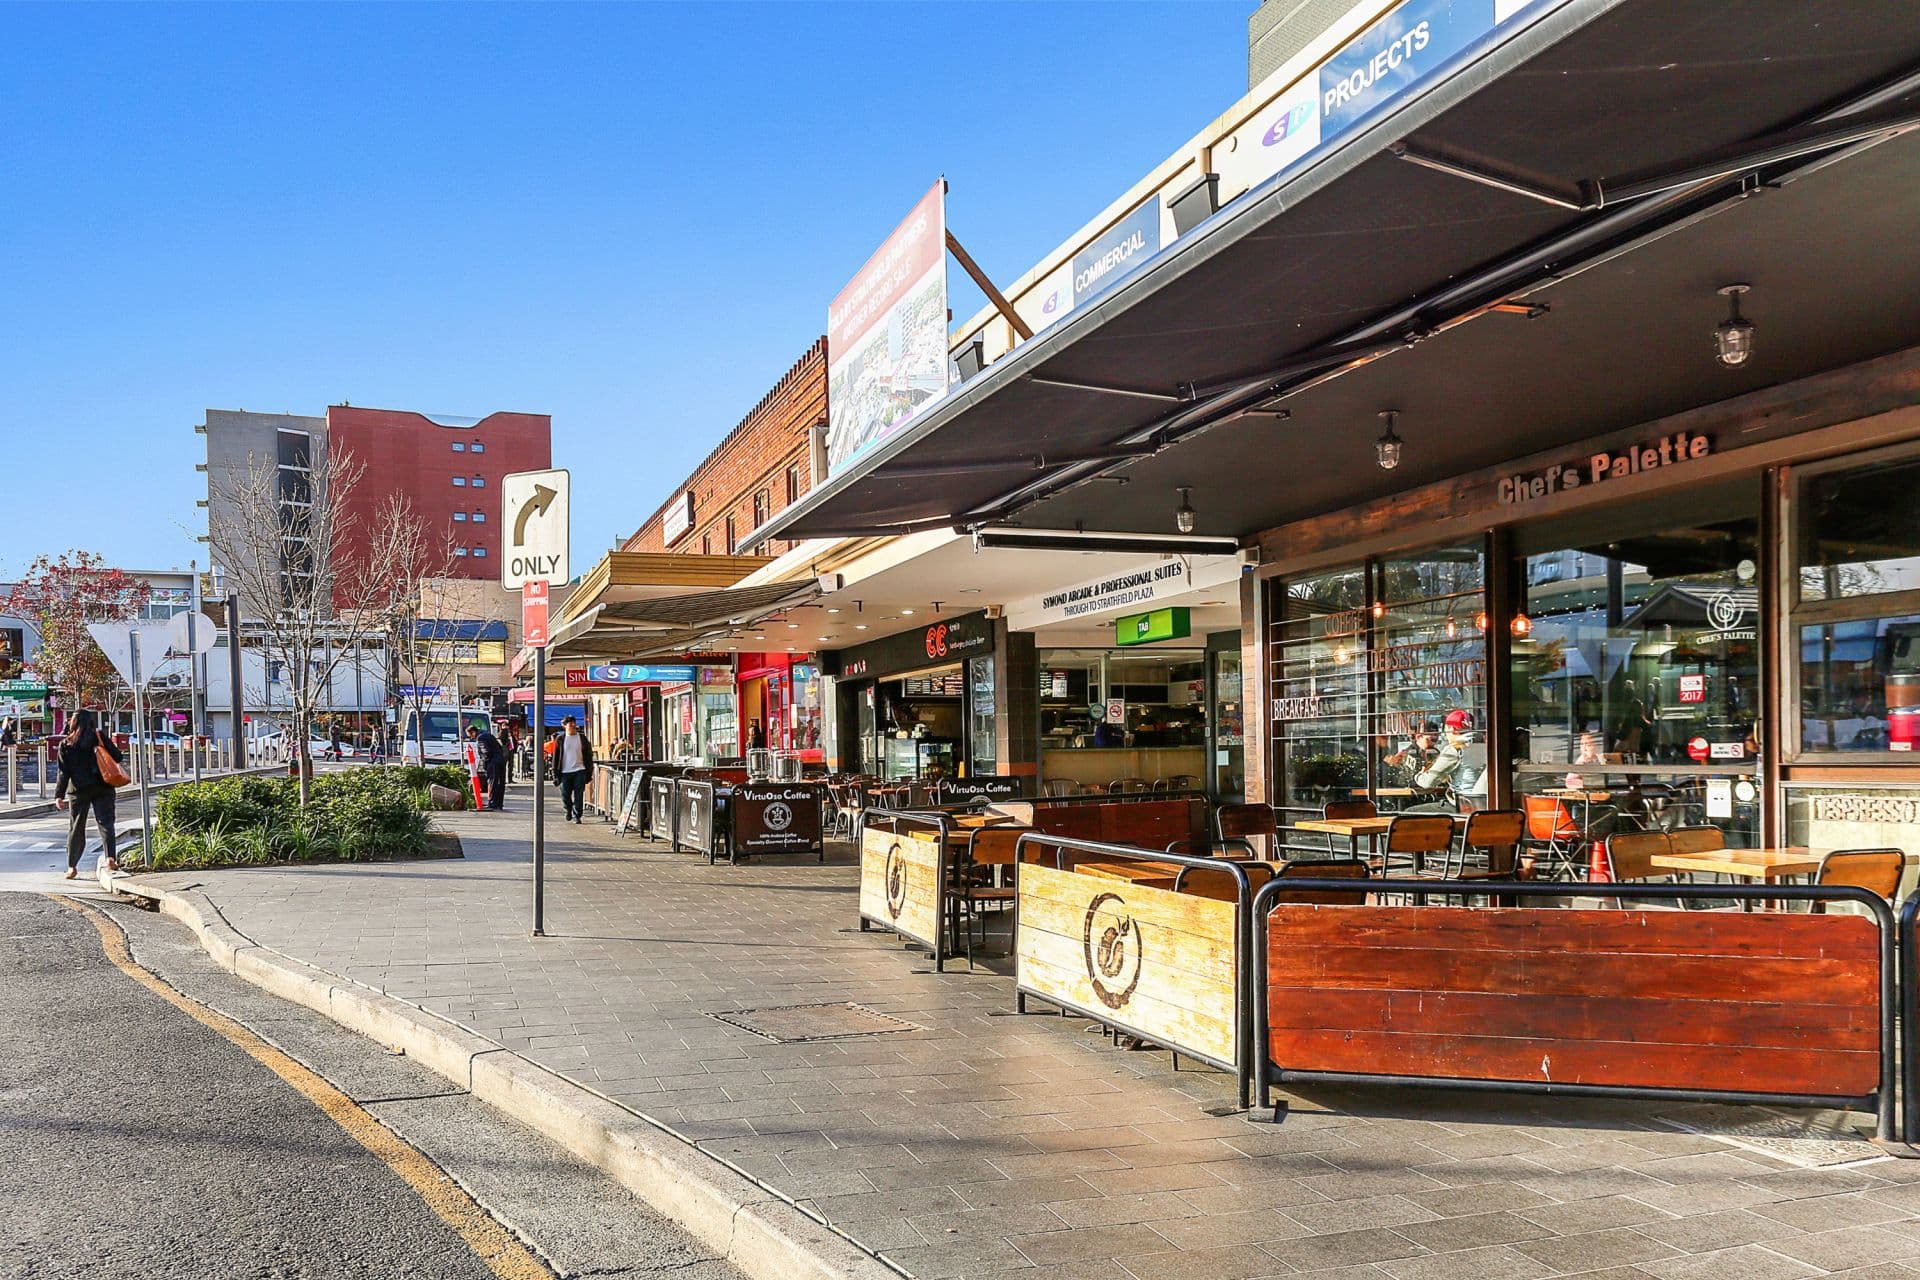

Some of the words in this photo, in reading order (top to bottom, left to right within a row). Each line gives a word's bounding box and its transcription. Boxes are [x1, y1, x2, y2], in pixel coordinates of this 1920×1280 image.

[1323, 20, 1430, 117] PROJECTS
[1075, 229, 1146, 293] COMMERCIAL
[1497, 464, 1580, 504] Chef's
[1591, 432, 1709, 484] Palette
[511, 554, 560, 577] ONLY
[1042, 593, 1067, 610] SYMOND
[1068, 587, 1093, 603] ARCADE
[1094, 584, 1100, 596] &
[1101, 570, 1152, 595] PROFESSIONAL
[1154, 561, 1182, 581] SUITES
[1063, 600, 1089, 617] THROUGH
[1088, 599, 1097, 611] TO
[1097, 591, 1133, 610] STRATHFIELD
[1133, 586, 1154, 602] PLAZA
[1138, 620, 1149, 633] TAB
[1325, 609, 1366, 637] COFFEE
[1696, 633, 1721, 644] CHEF'S
[1723, 631, 1757, 640] PALETTE
[607, 667, 641, 679] SP
[1429, 660, 1487, 689] BRUNCH
[1274, 697, 1320, 719] BREAKFAST
[1680, 691, 1703, 701] 2017
[1386, 710, 1426, 735] LUNCH
[783, 789, 811, 800] Coffee
[986, 782, 1012, 793] Coffee
